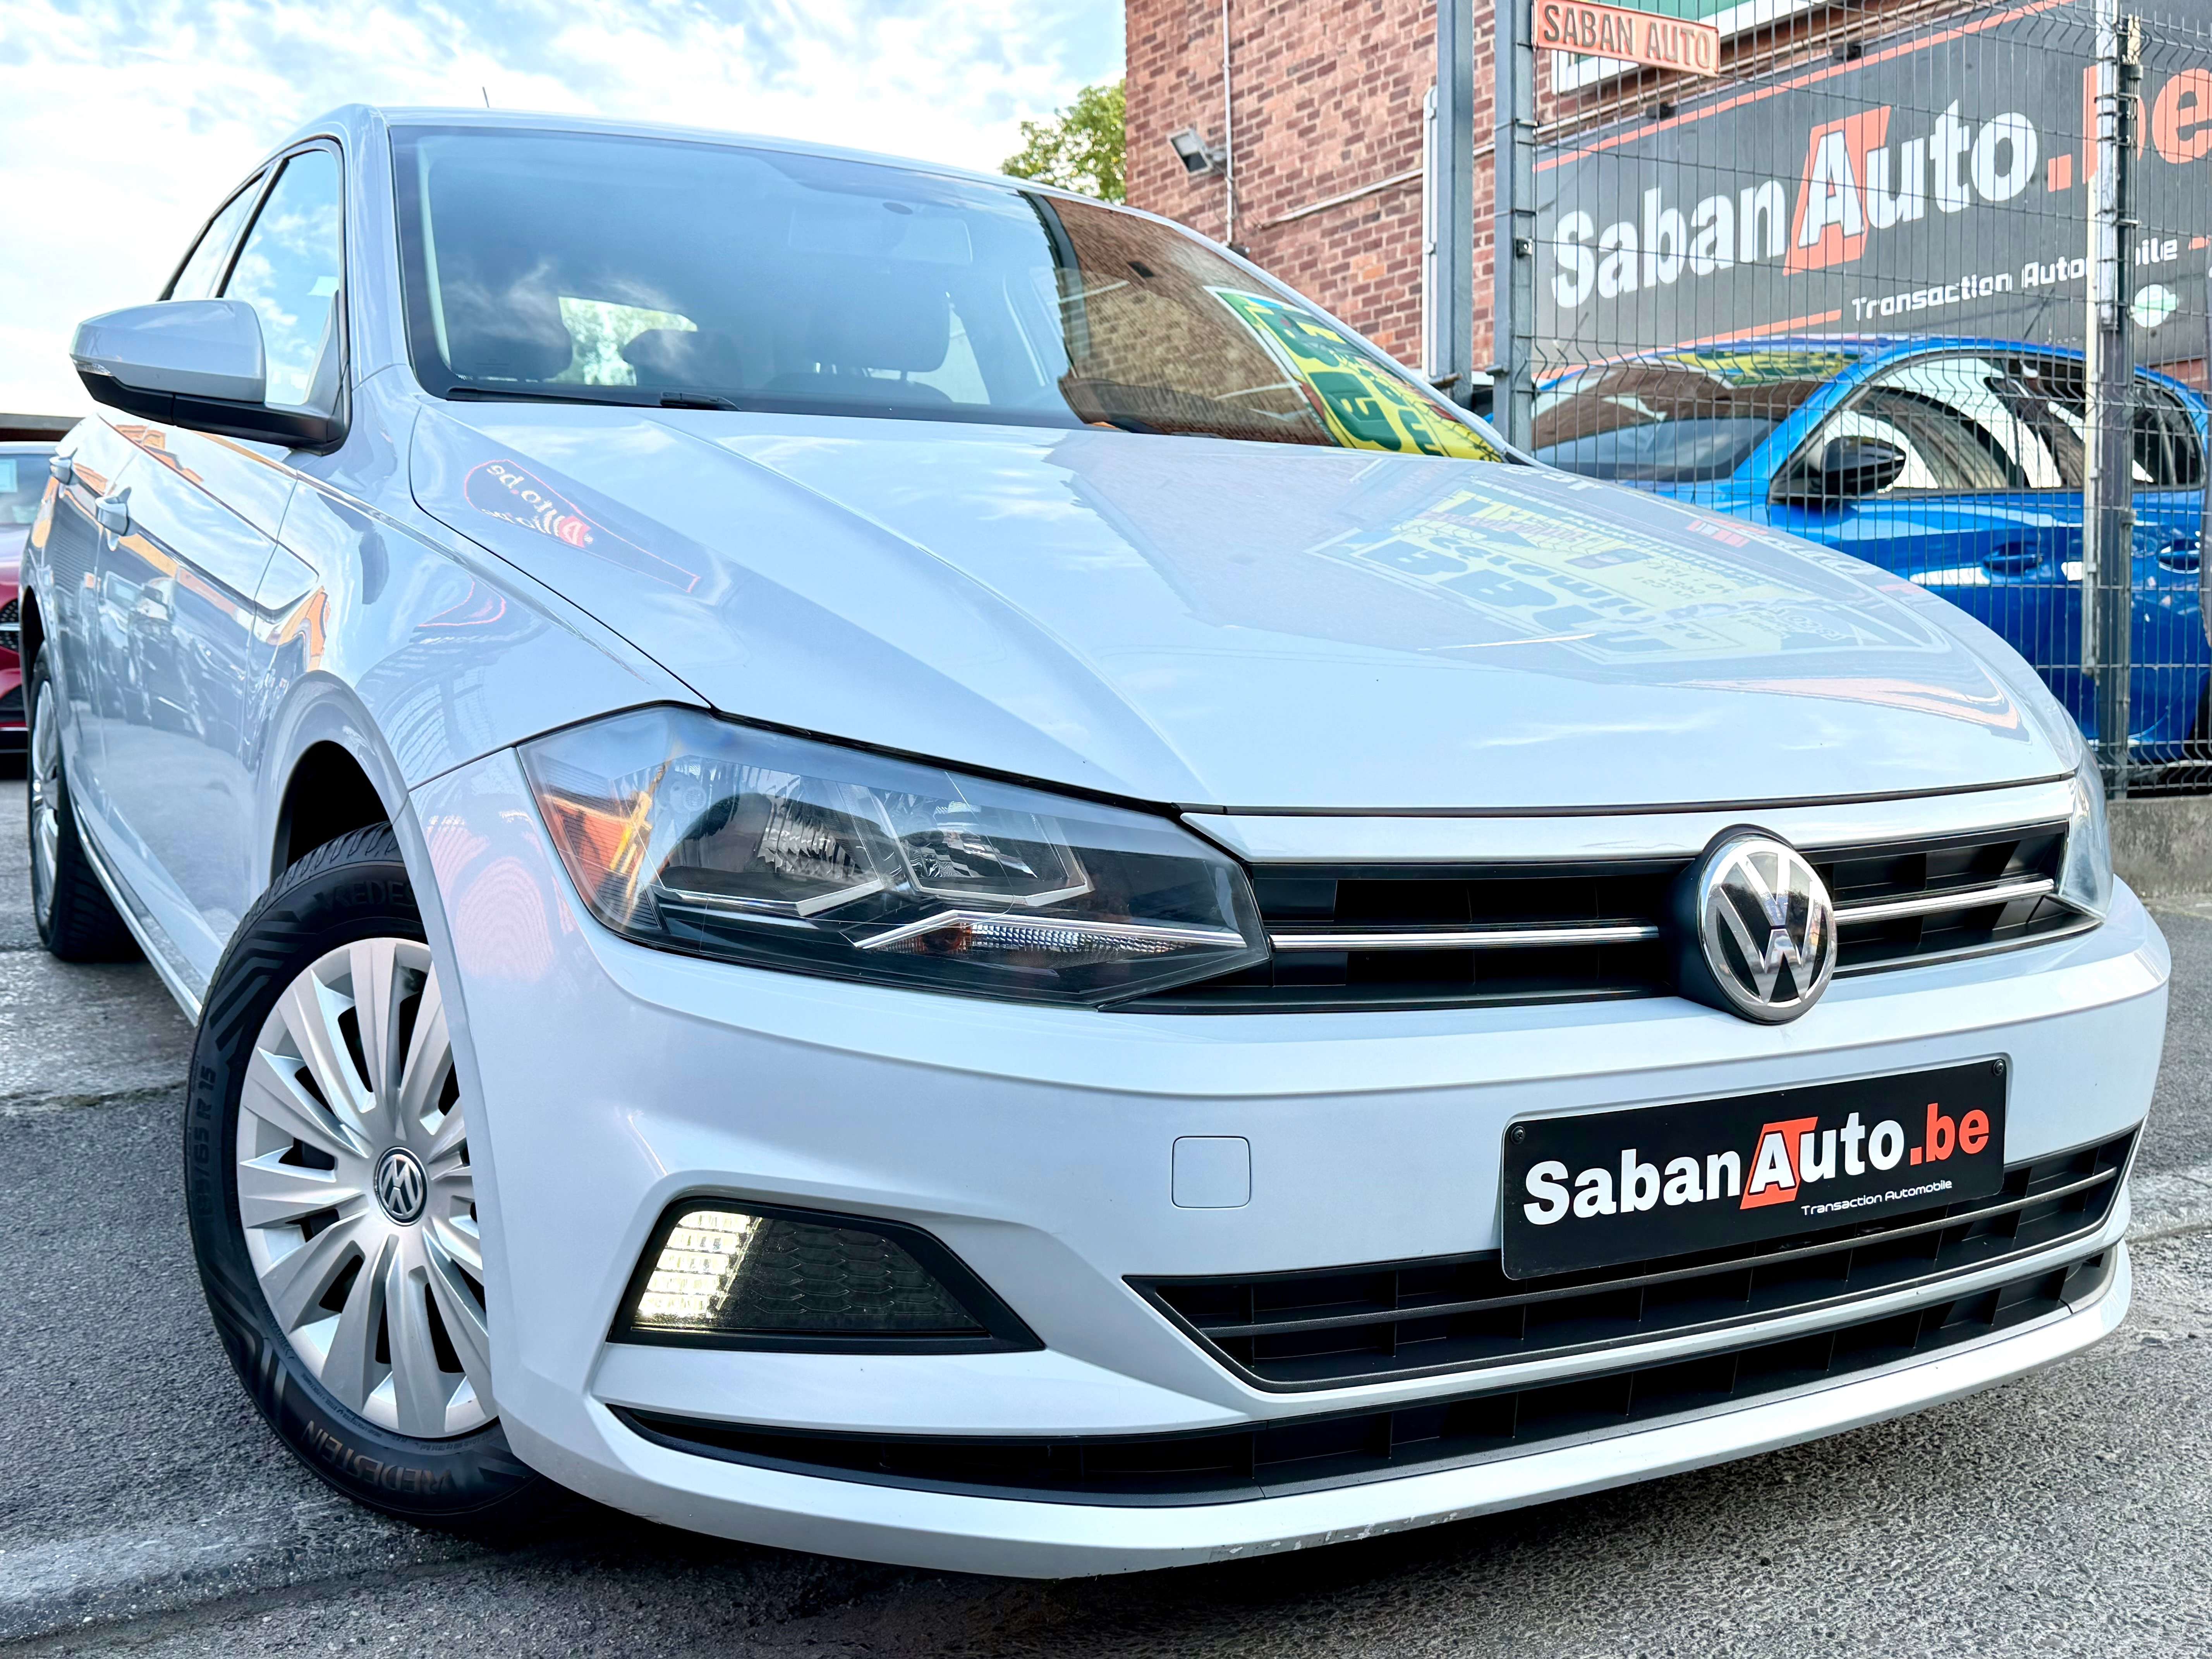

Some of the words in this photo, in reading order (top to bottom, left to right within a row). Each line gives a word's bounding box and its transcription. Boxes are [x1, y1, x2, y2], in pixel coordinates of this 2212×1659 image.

[1544, 5, 1633, 55] SABAN
[1646, 22, 1711, 69] AUTO
[1852, 273, 2013, 321] Transaction
[2021, 237, 2178, 289] Autoile
[1523, 1102, 1989, 1225] SabanAuto.be
[1801, 1195, 1882, 1216] Transaction
[1885, 1180, 1953, 1201] Automobile
